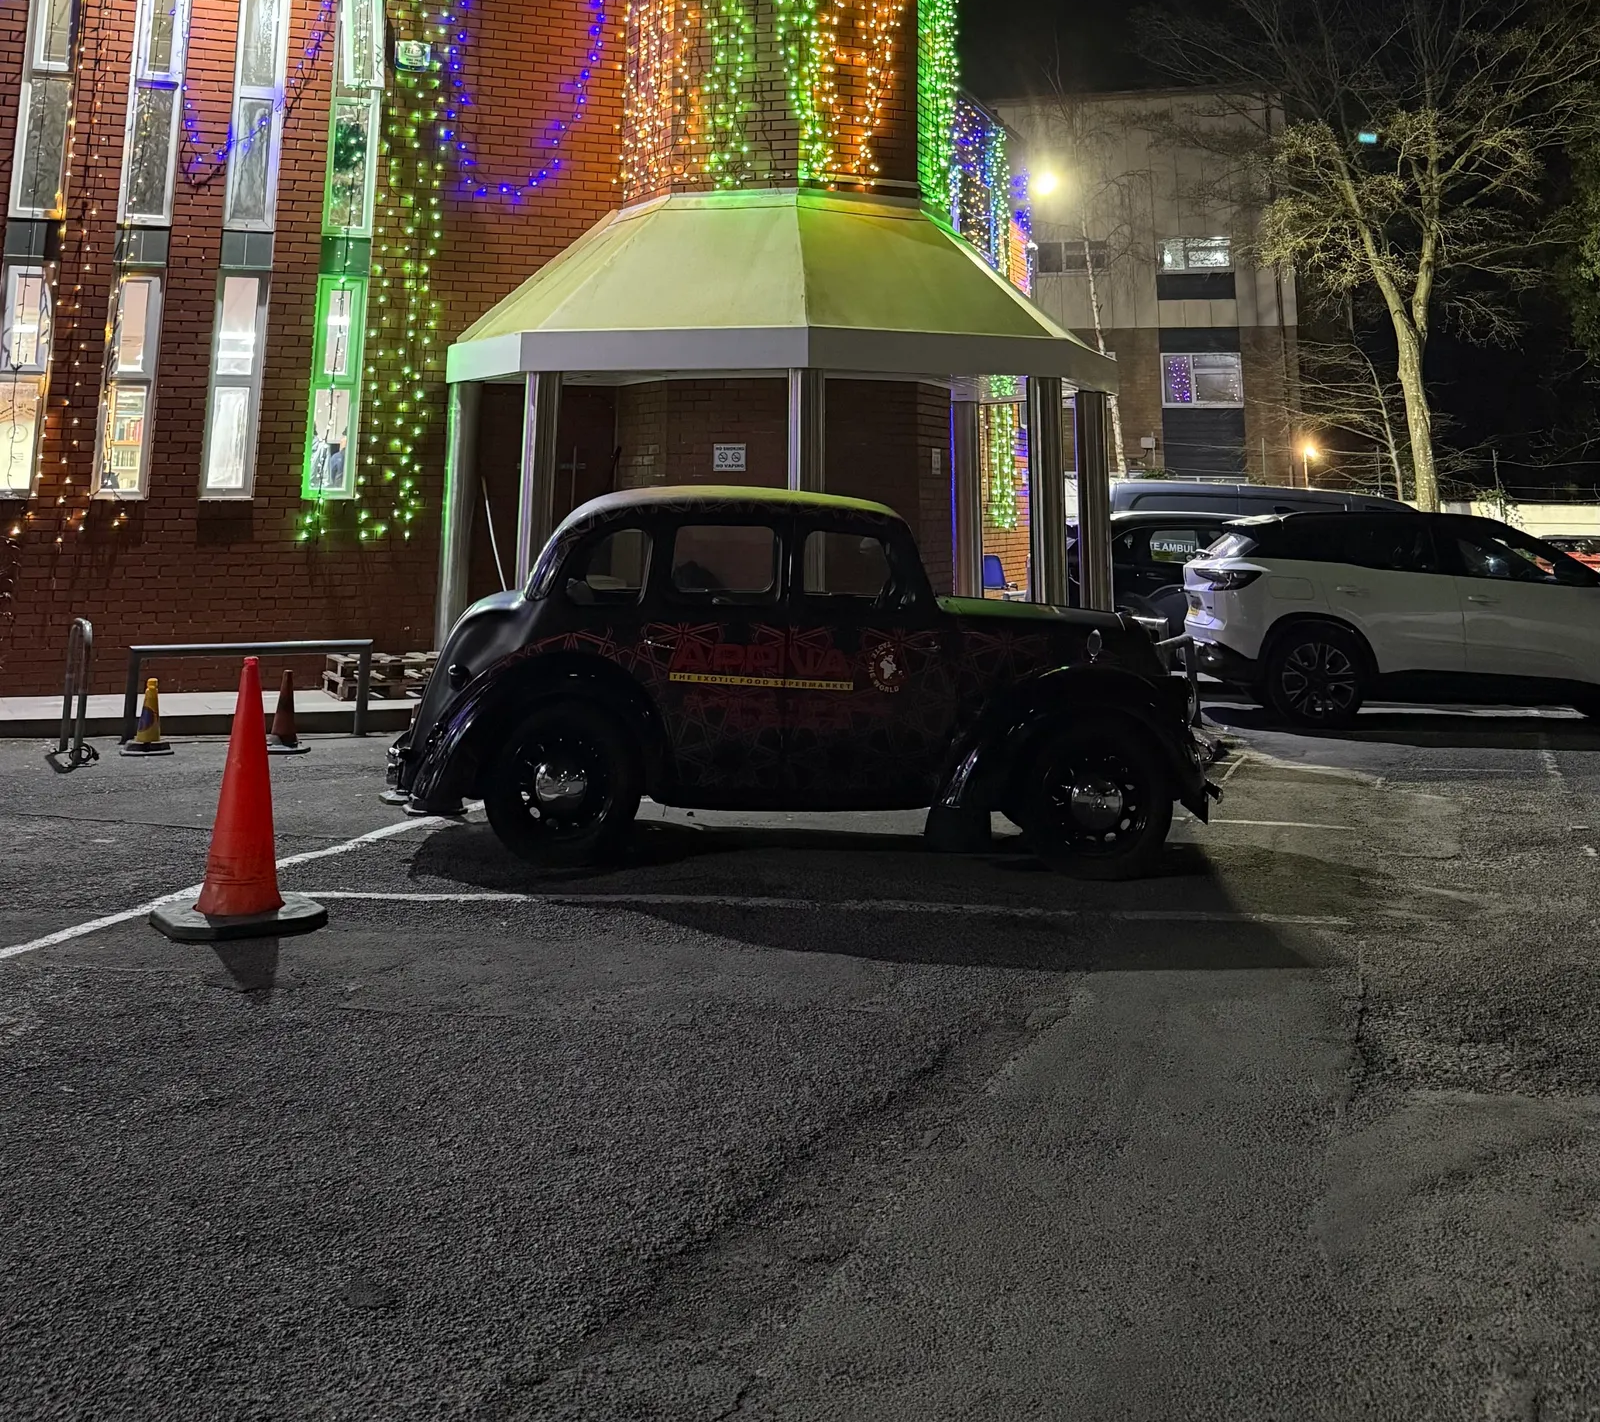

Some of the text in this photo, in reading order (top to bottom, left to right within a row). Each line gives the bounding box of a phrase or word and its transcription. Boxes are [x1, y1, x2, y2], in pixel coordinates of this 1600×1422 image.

[672, 673, 693, 681] THE
[697, 675, 736, 683] EXOTIC
[774, 679, 851, 689] SUPERMARKET
[868, 641, 899, 693] TASTE THE WORLD
